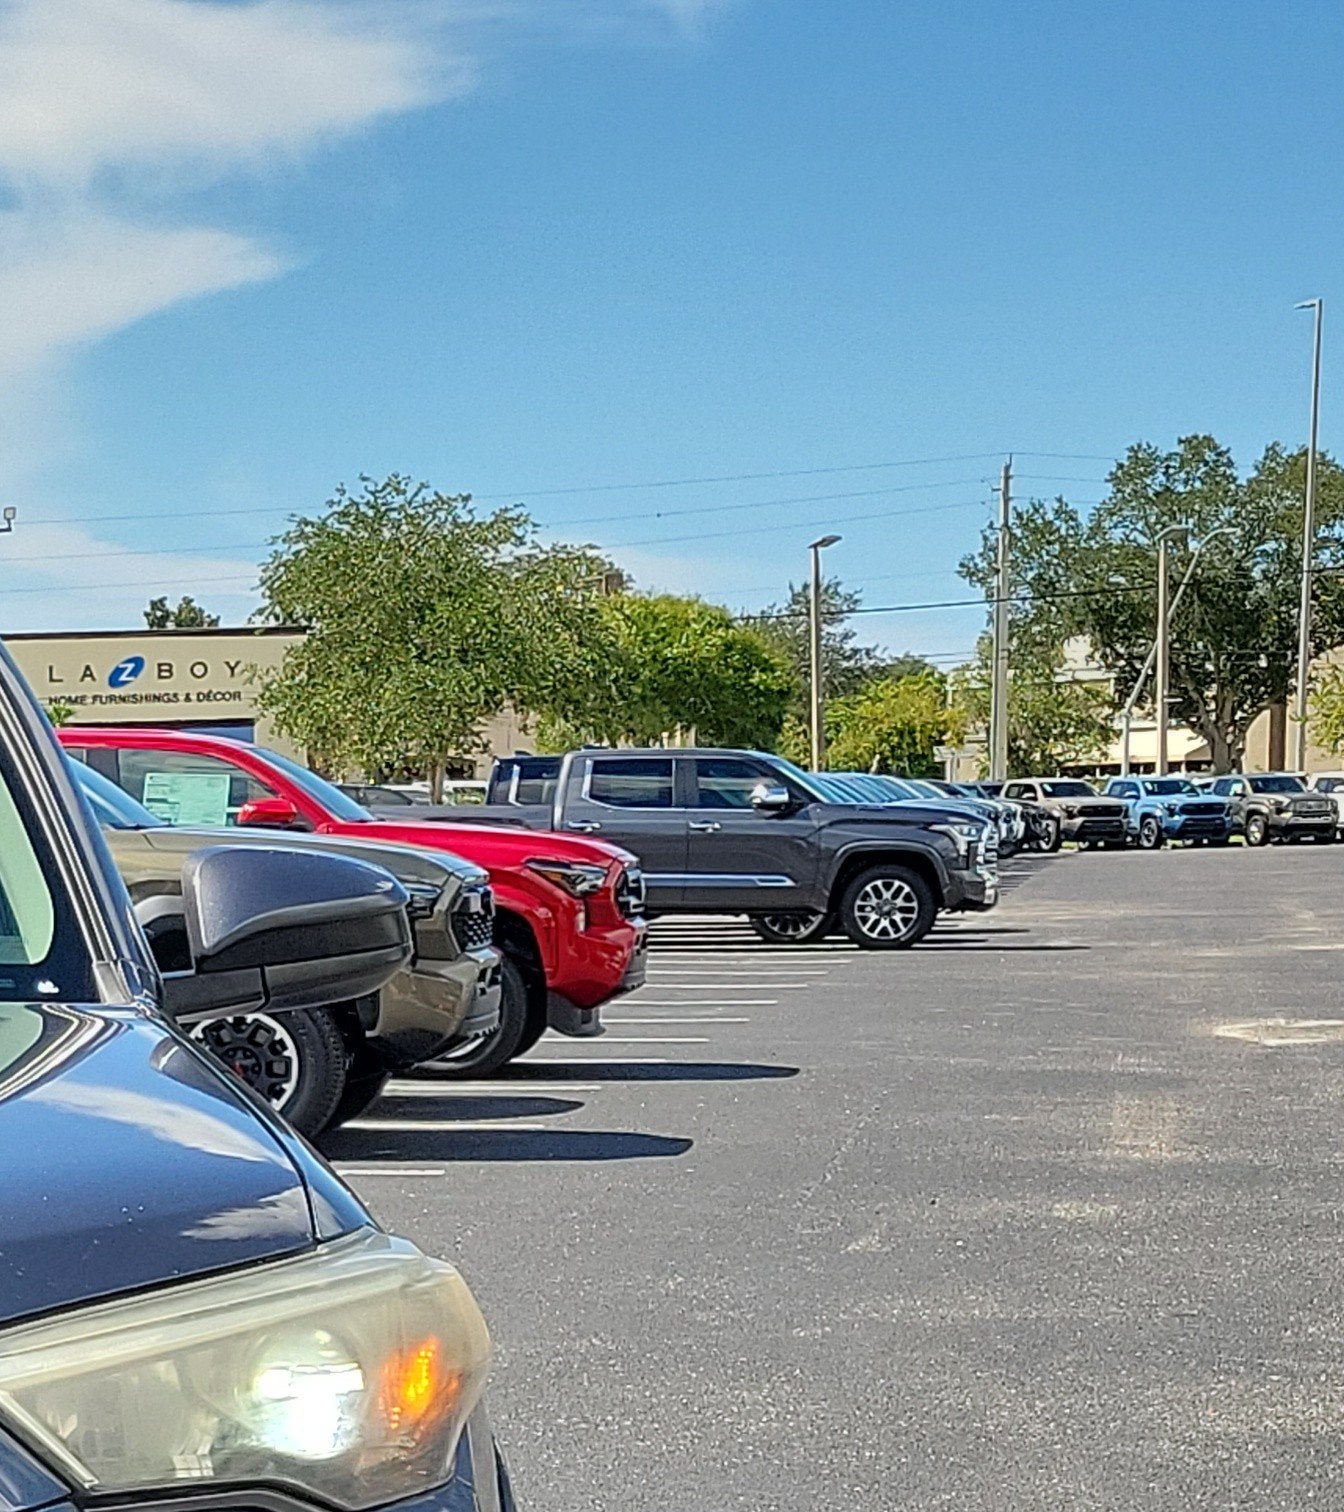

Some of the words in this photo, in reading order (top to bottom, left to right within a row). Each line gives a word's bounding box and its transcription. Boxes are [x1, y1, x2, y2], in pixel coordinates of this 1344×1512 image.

[49, 695, 87, 706] HOME
[92, 693, 180, 705] FURNISHINGS
[184, 692, 192, 703] &
[197, 690, 241, 703] DÉCOR
